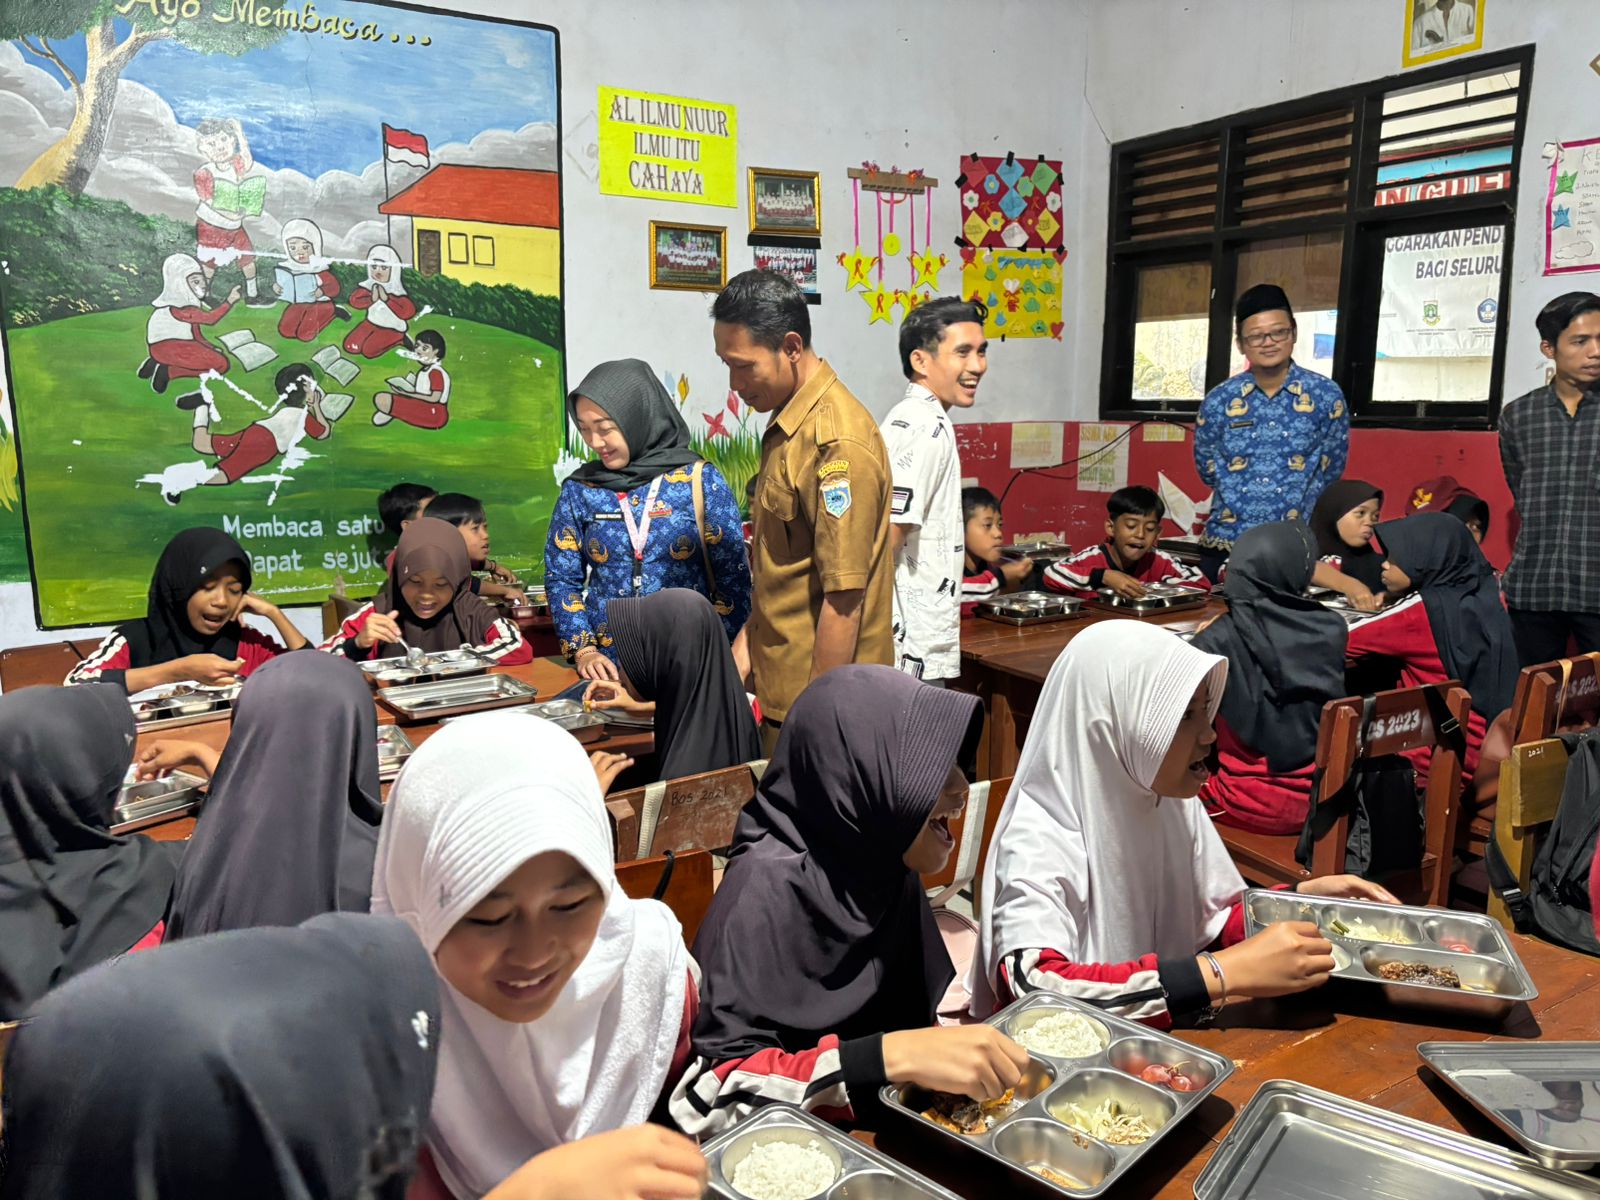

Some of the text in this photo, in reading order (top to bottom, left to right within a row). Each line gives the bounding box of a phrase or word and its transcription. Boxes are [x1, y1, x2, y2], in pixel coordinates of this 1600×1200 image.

[609, 94, 728, 137] AL ILMU NUUR
[634, 131, 700, 162] ILMU ITU
[628, 160, 703, 195] CAHAYA
[1416, 260, 1449, 279] BAGI
[222, 514, 386, 539] Membaca satu
[1386, 709, 1420, 736] 2023
